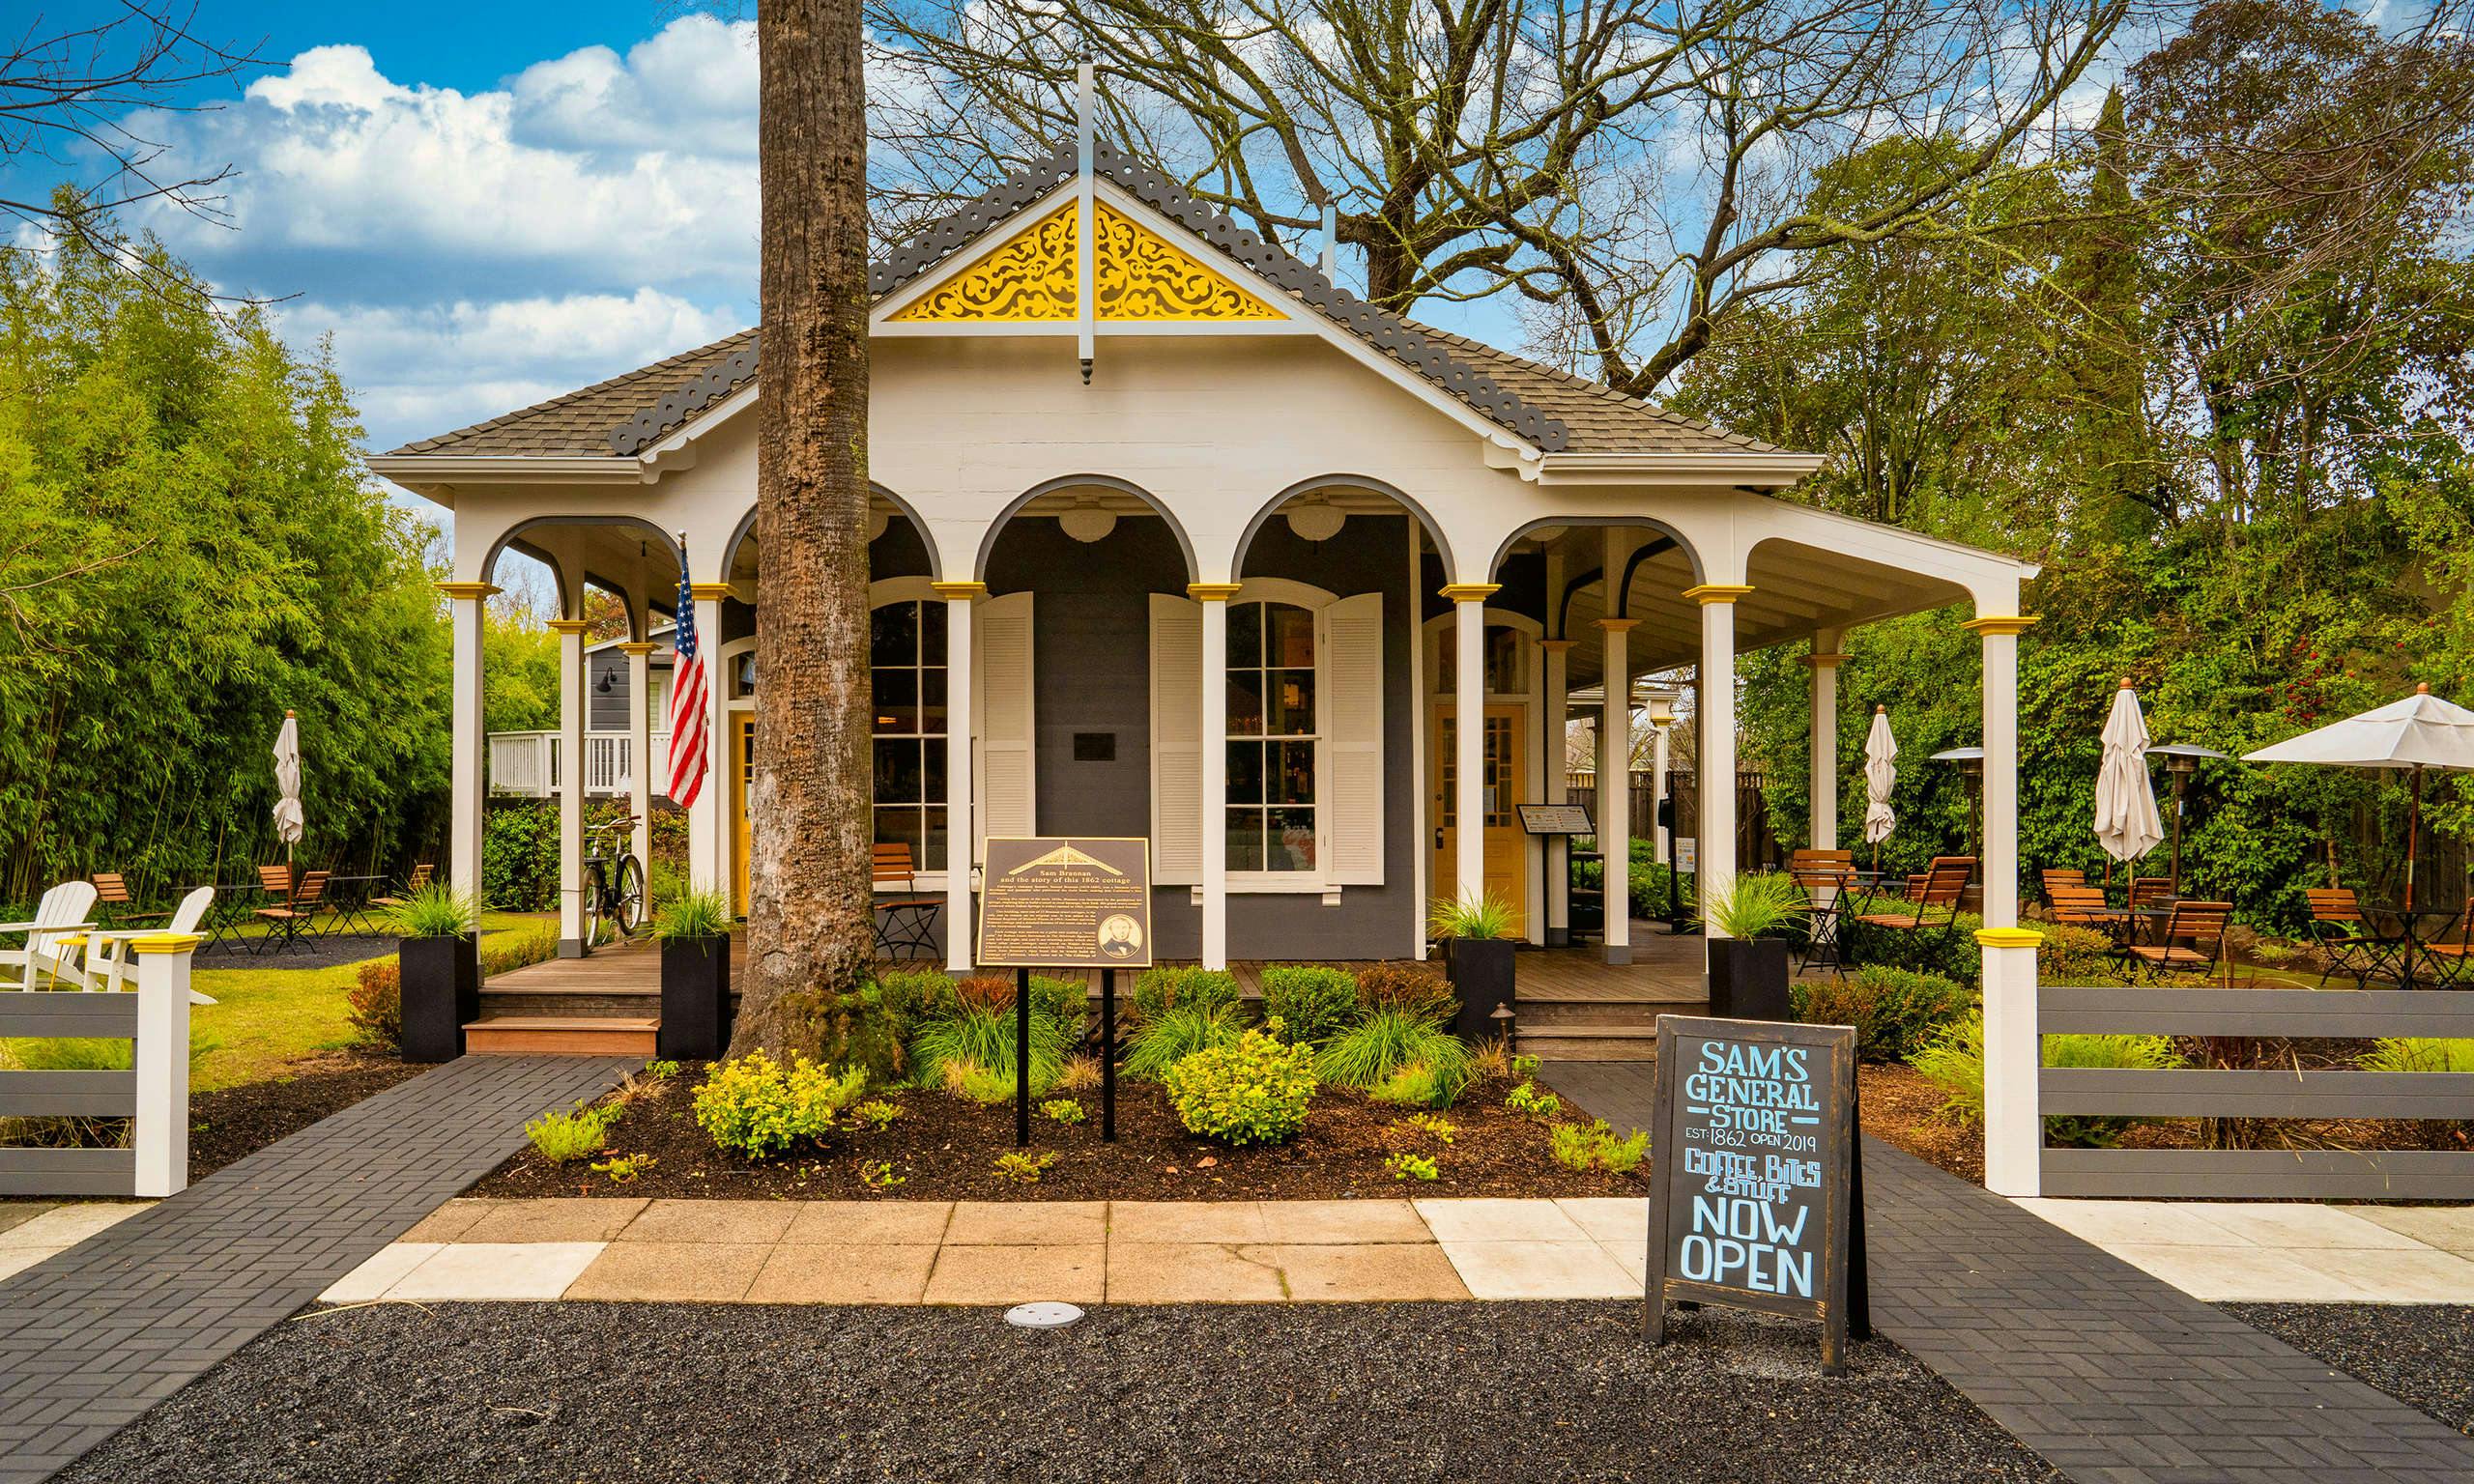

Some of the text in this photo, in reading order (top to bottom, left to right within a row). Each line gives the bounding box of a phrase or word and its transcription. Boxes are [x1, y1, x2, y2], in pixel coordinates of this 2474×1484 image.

[1699, 1042, 1809, 1082] SAM'S
[1685, 1073, 1819, 1111] GENERAL
[1710, 1104, 1788, 1134] STORE
[1711, 1127, 1747, 1148] 1862
[1750, 1132, 1781, 1147] OPEN
[1783, 1134, 1817, 1153] 2019
[1766, 1155, 1821, 1188] BITES
[1693, 1195, 1809, 1246] NOW
[1680, 1235, 1813, 1298] OPEN
